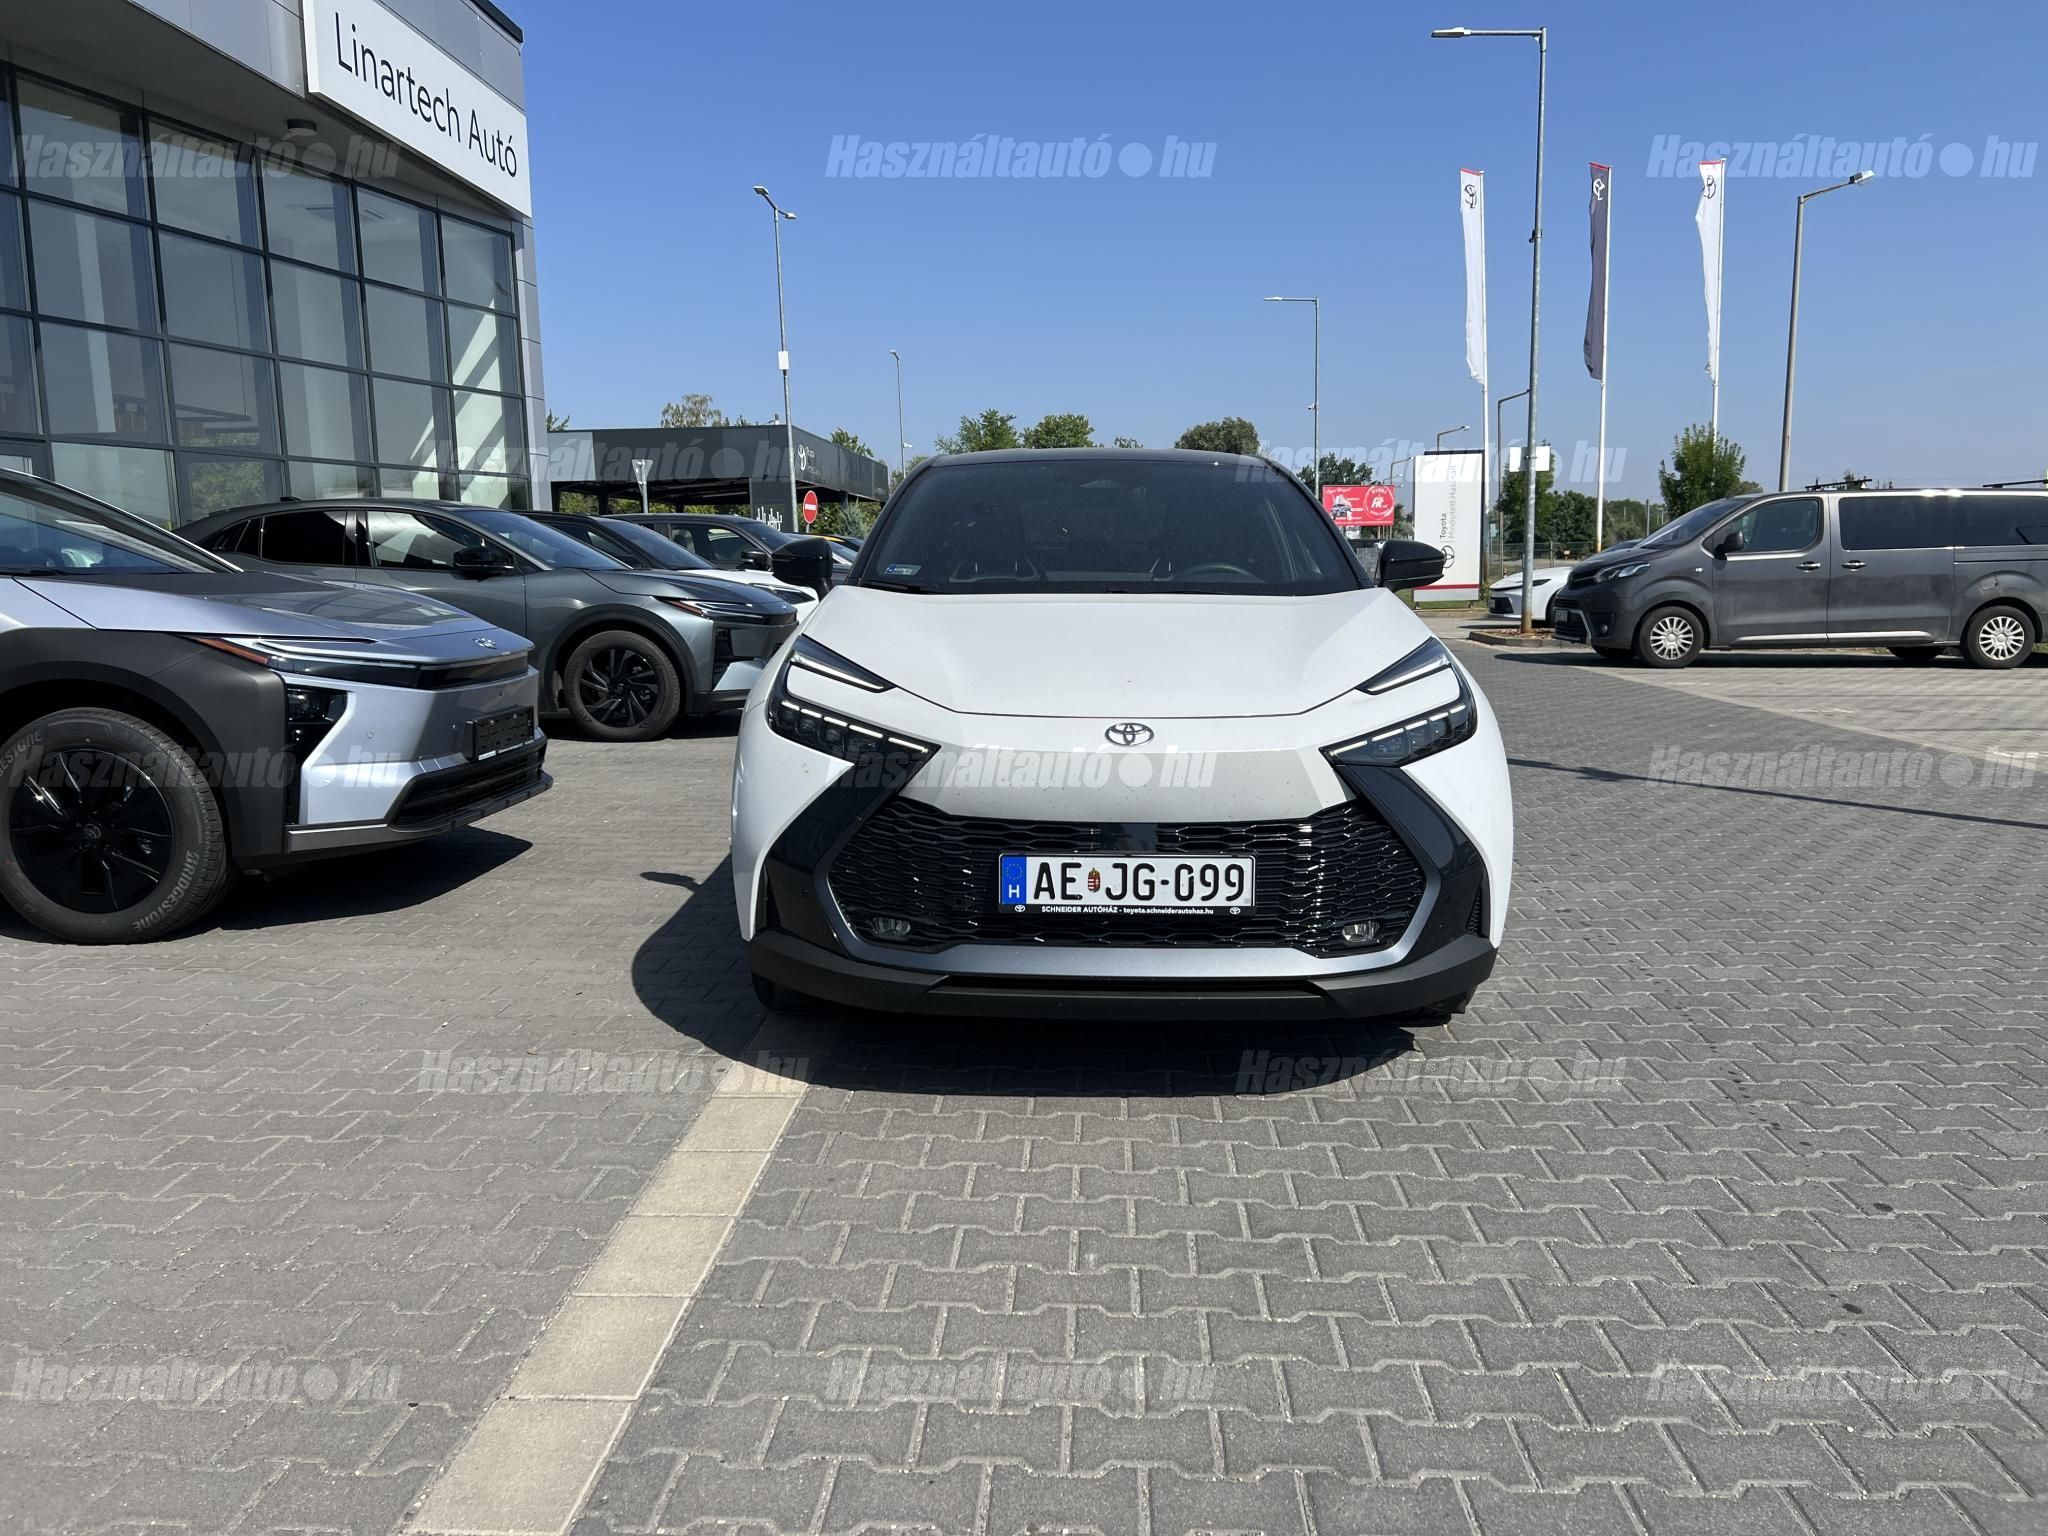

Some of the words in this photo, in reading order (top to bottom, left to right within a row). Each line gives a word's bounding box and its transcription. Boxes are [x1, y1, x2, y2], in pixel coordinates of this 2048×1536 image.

[335, 12, 461, 143] Linartech
[468, 109, 517, 178] Autó
[1008, 884, 1020, 898] H
[1033, 861, 1083, 900] AE
[1105, 862, 1245, 902] JG-099
[1041, 905, 1082, 914] SCHNEIDER
[1083, 904, 1118, 914] AUTÓHÁZ
